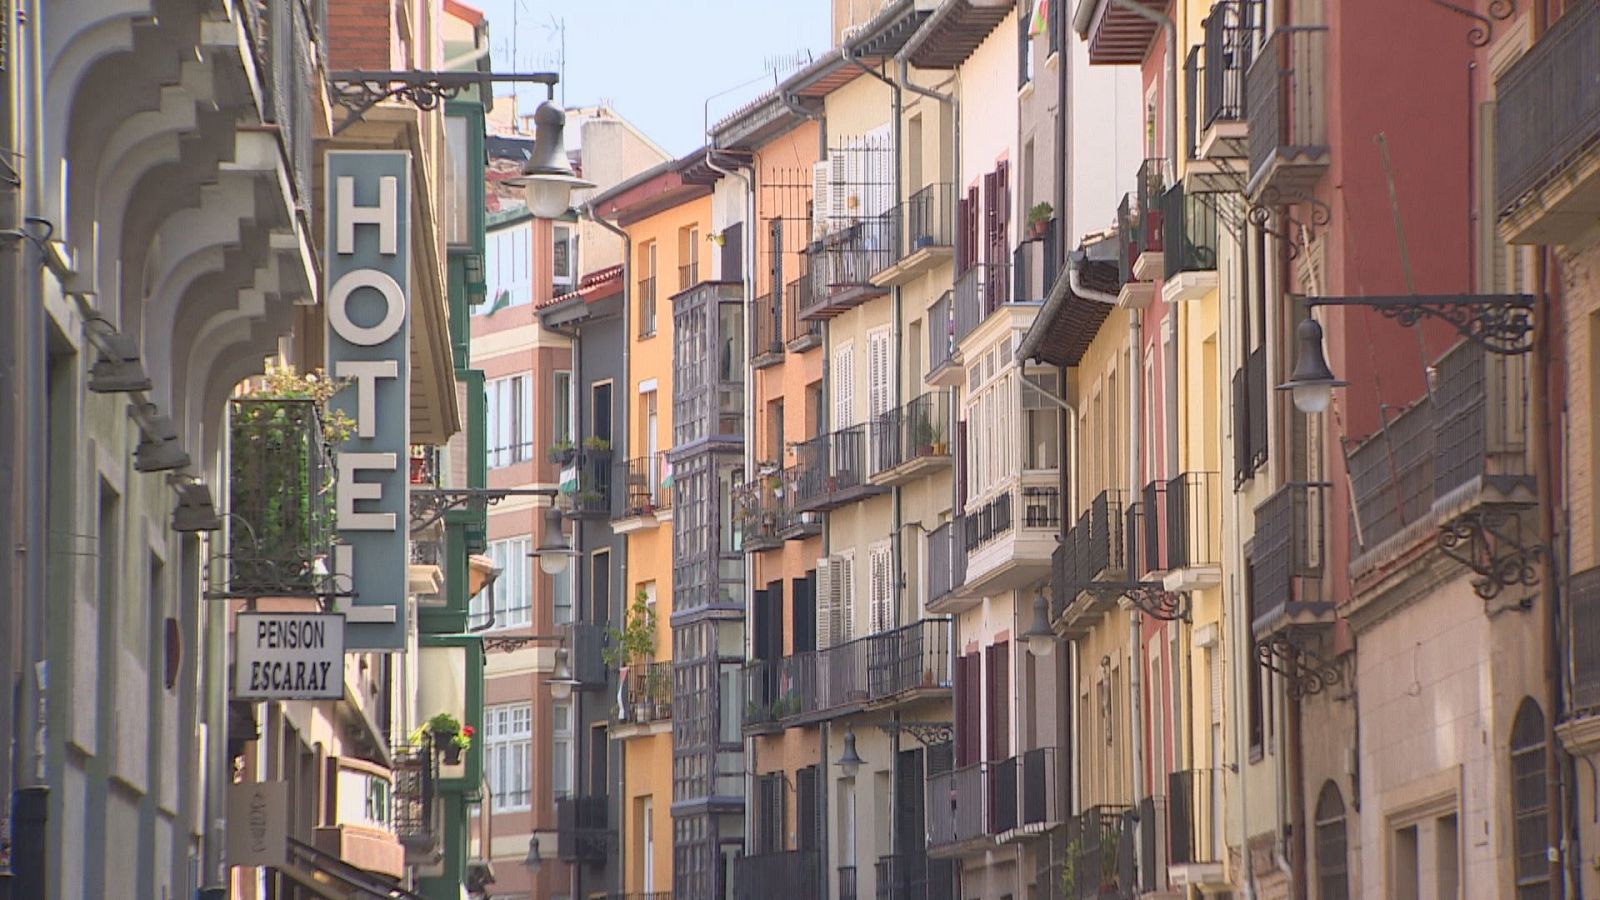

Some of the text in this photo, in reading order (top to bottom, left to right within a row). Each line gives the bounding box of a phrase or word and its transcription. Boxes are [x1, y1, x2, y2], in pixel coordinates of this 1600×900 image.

[329, 176, 406, 623] HOTEL
[257, 620, 325, 648] PENSION
[249, 661, 331, 691] ESCARAY
